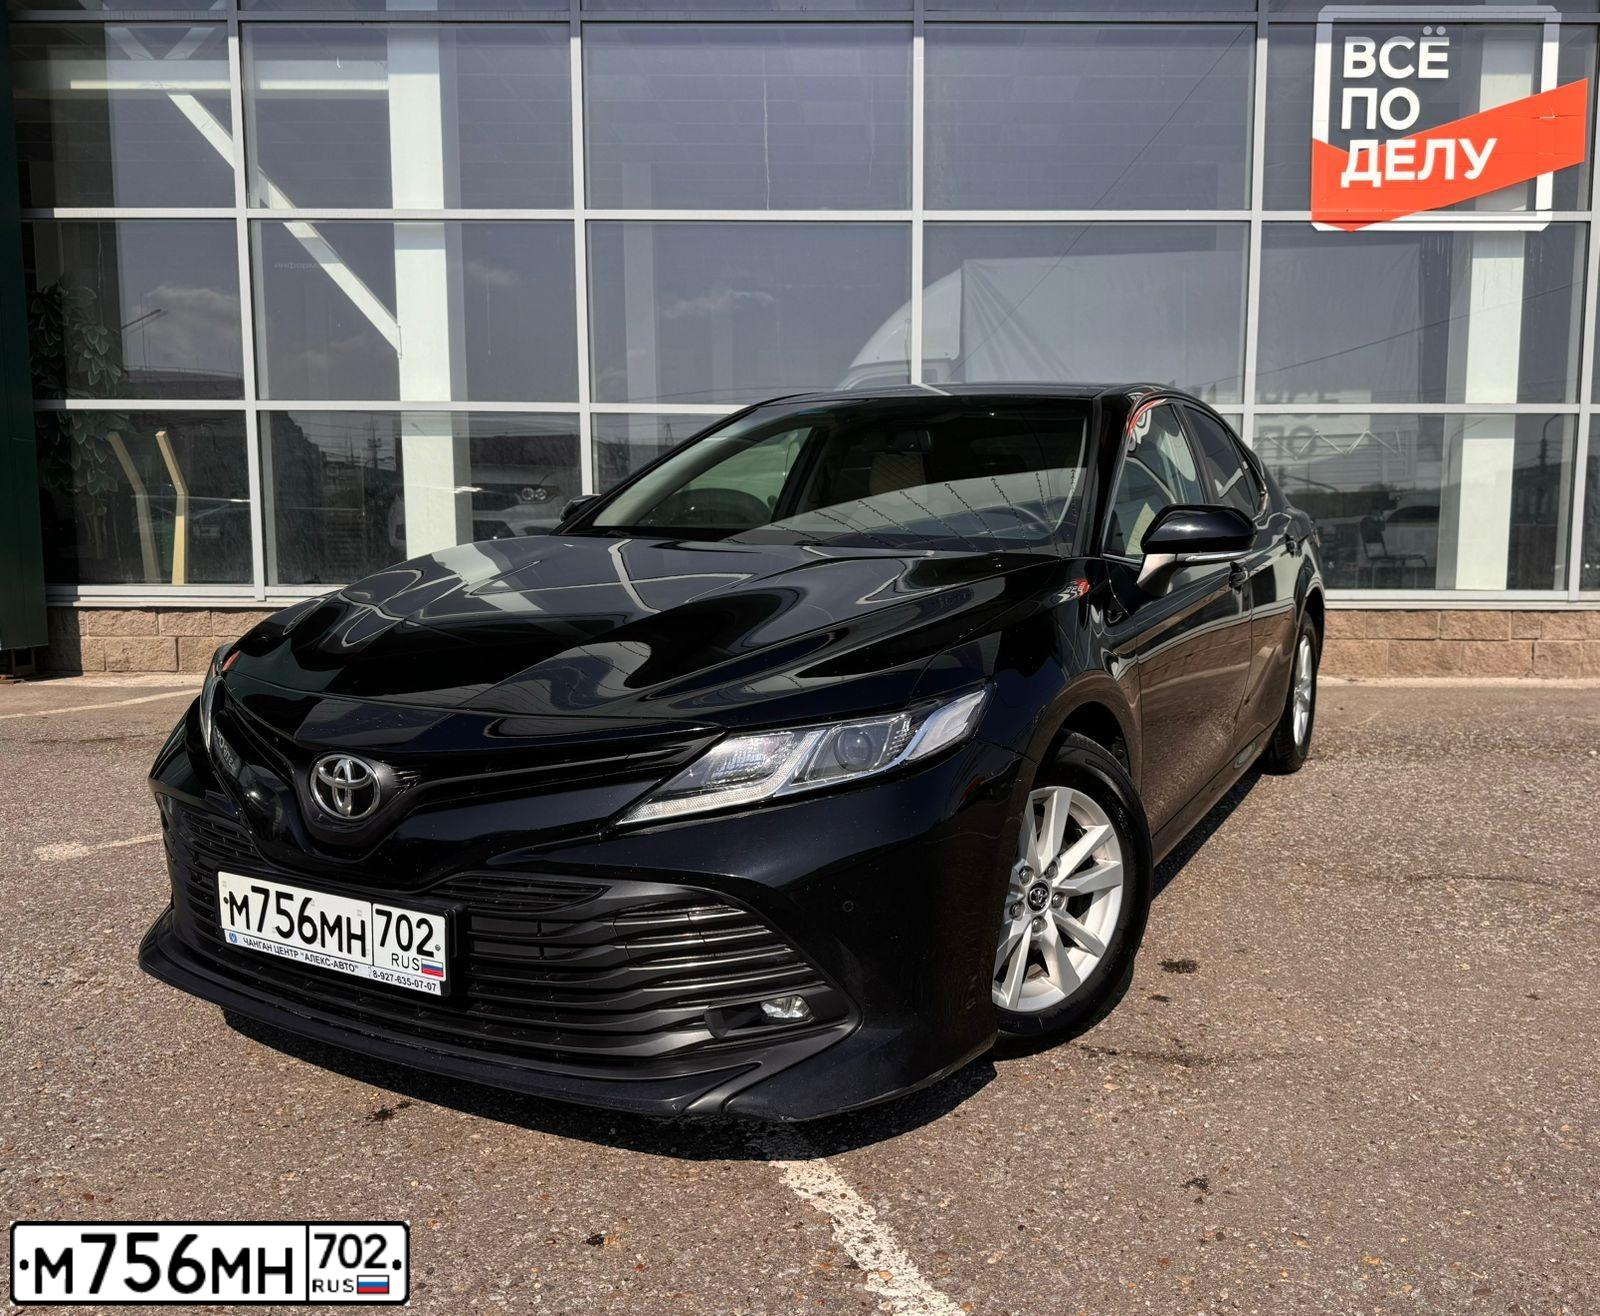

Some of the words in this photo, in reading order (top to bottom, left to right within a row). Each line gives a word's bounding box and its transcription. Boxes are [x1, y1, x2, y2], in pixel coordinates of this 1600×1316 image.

[1342, 25, 1450, 79] ВСЁ
[1341, 87, 1420, 130] ПО
[1340, 138, 1498, 188] ДЕЛУ
[228, 885, 367, 958] М756МН
[375, 908, 435, 958] 702
[242, 936, 274, 951] ЧАНГАН
[274, 944, 299, 959] ЦЕНТР
[391, 952, 420, 972] RUS
[372, 969, 437, 992] 8-927-635-07-07
